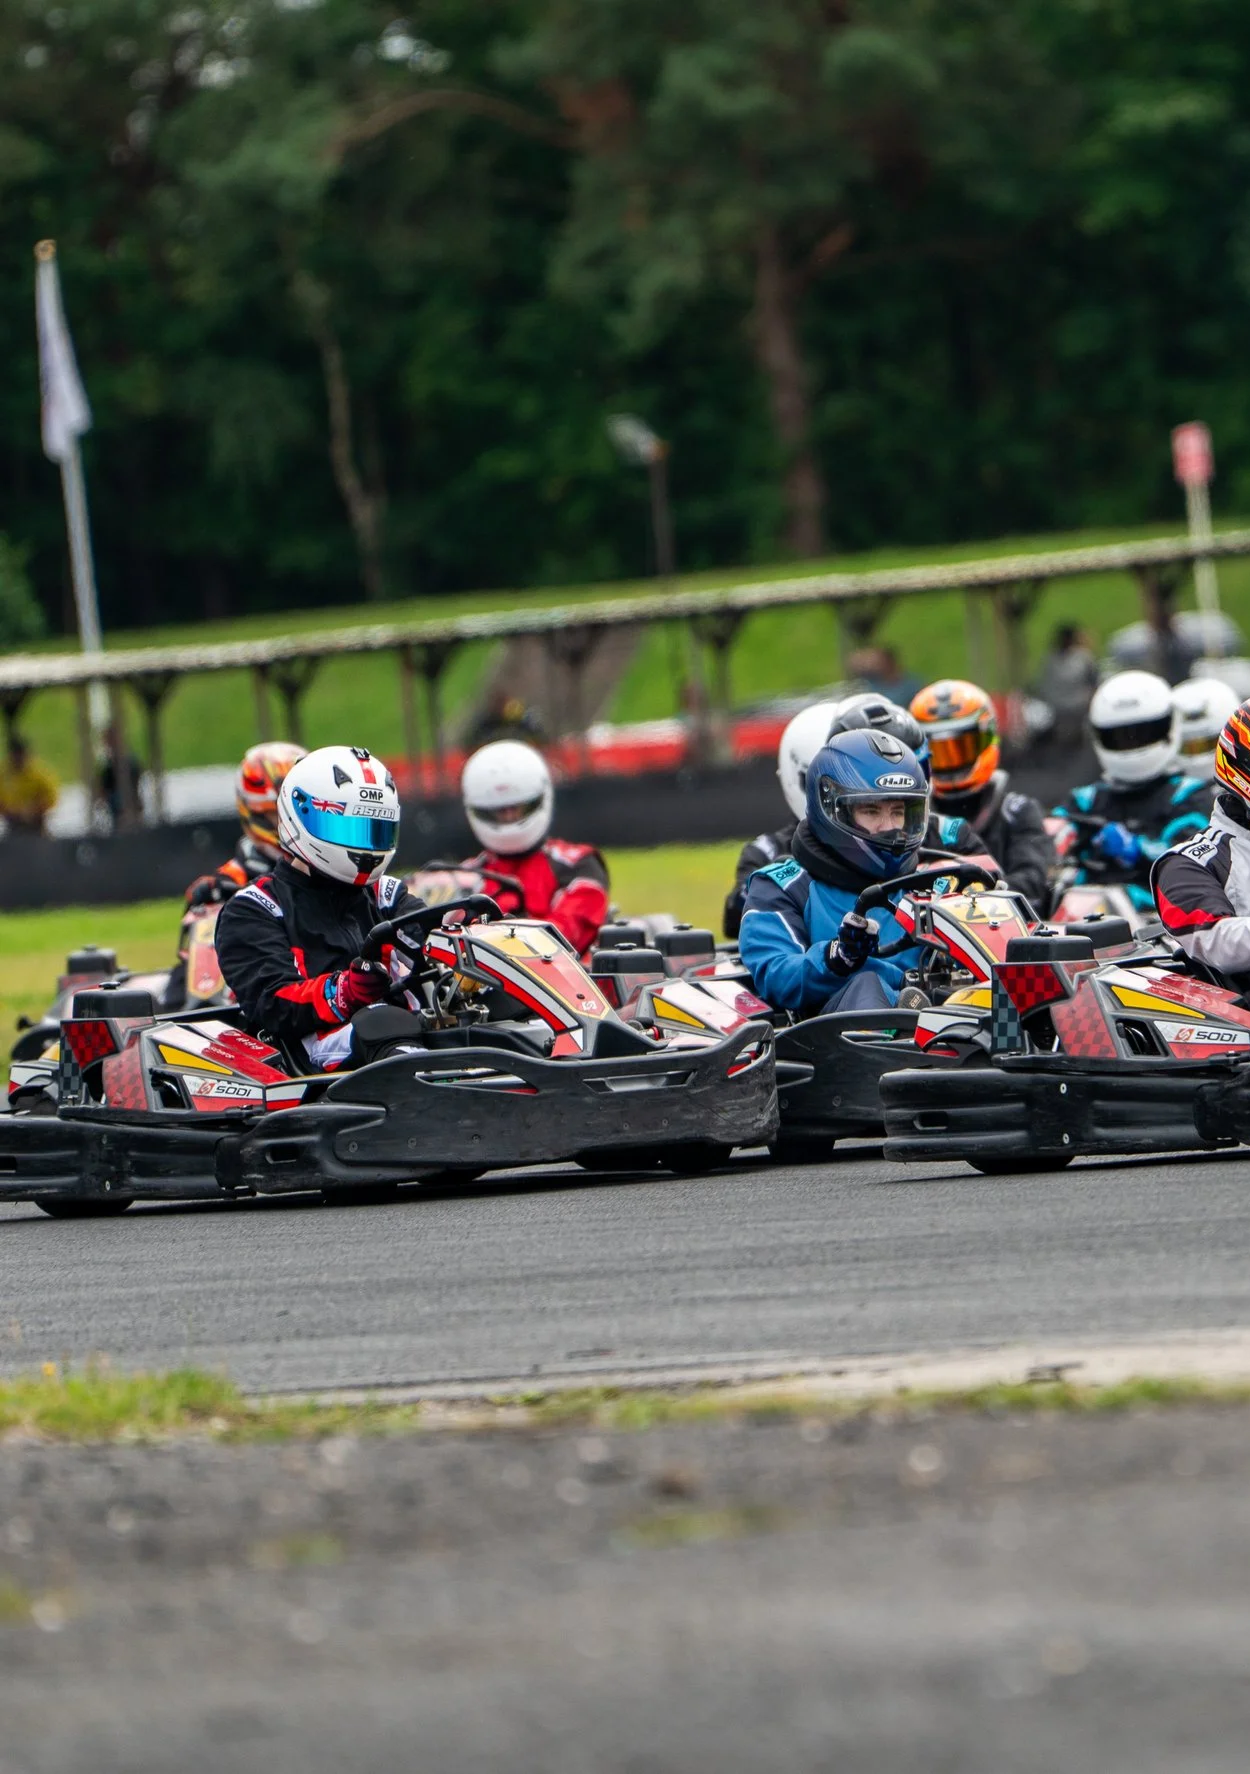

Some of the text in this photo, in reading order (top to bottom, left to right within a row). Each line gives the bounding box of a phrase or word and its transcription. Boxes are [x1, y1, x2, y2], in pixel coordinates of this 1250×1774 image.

[882, 775, 912, 786] HJC
[359, 789, 384, 801] OMP
[1190, 842, 1214, 858] OMP
[215, 1085, 252, 1097] SODI
